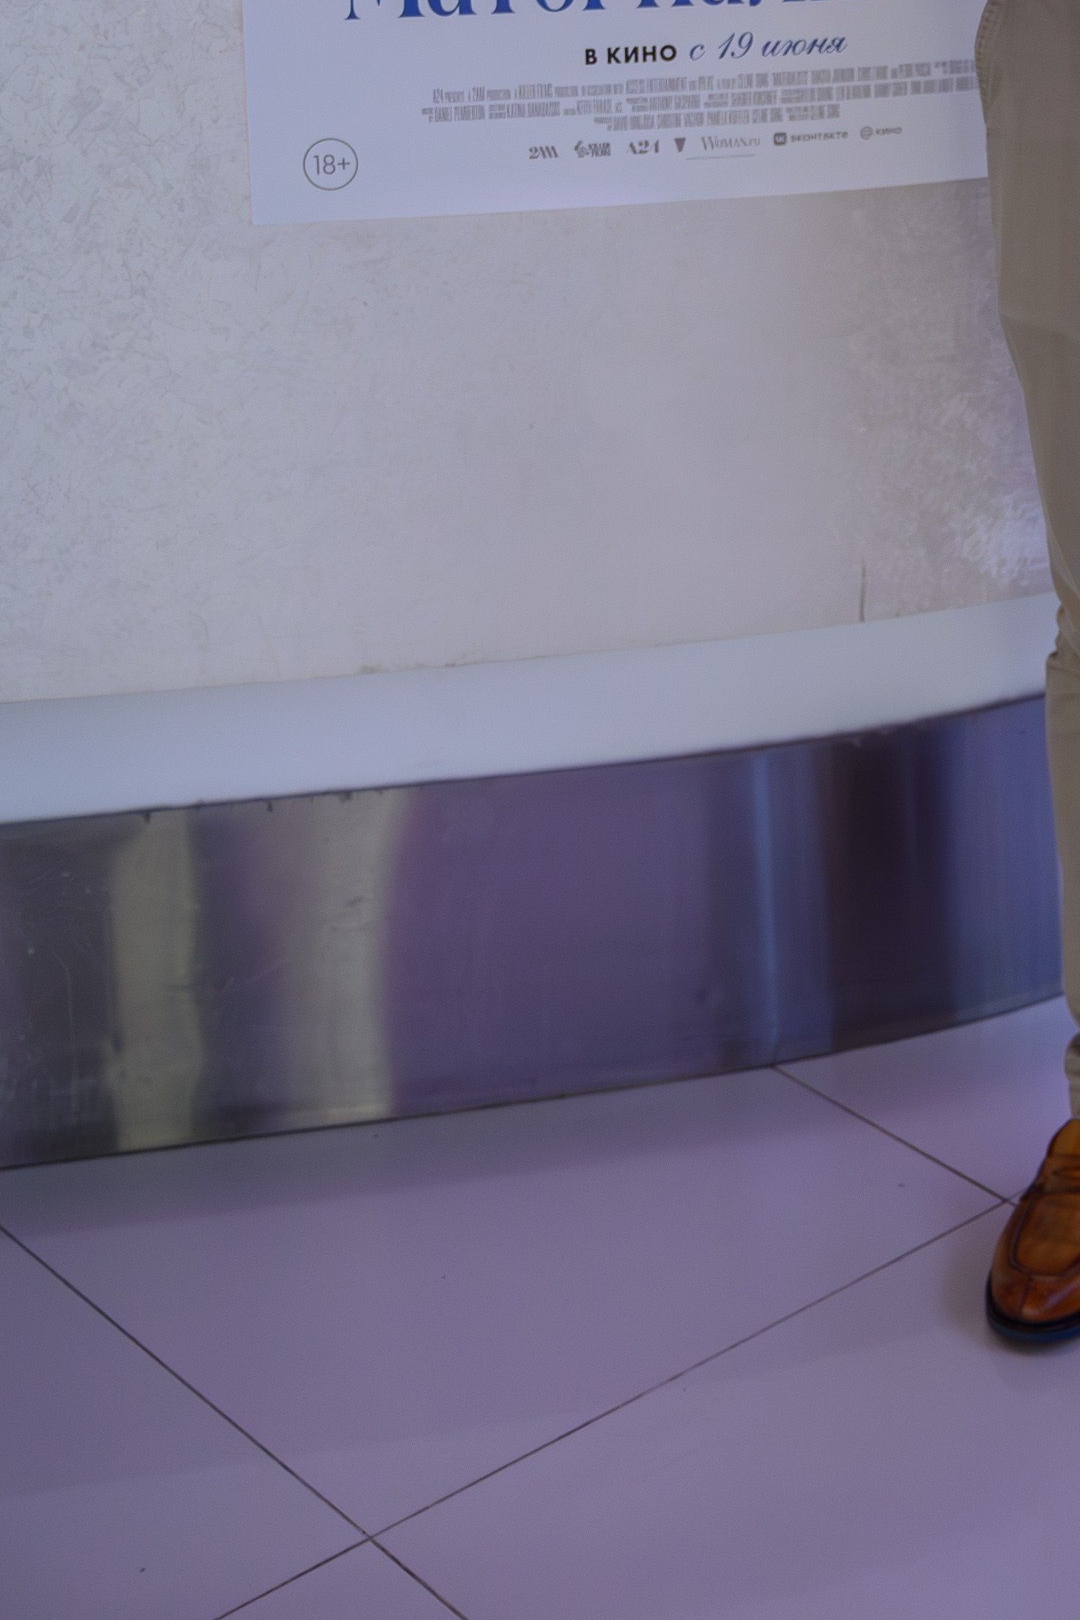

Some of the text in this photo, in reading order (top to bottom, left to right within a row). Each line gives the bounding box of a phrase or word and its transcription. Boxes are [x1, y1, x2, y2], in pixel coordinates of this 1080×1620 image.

[585, 48, 598, 66] В
[607, 44, 678, 65] КИНО
[718, 31, 755, 60] 19
[761, 36, 847, 58] июня
[313, 154, 350, 175] 18+
